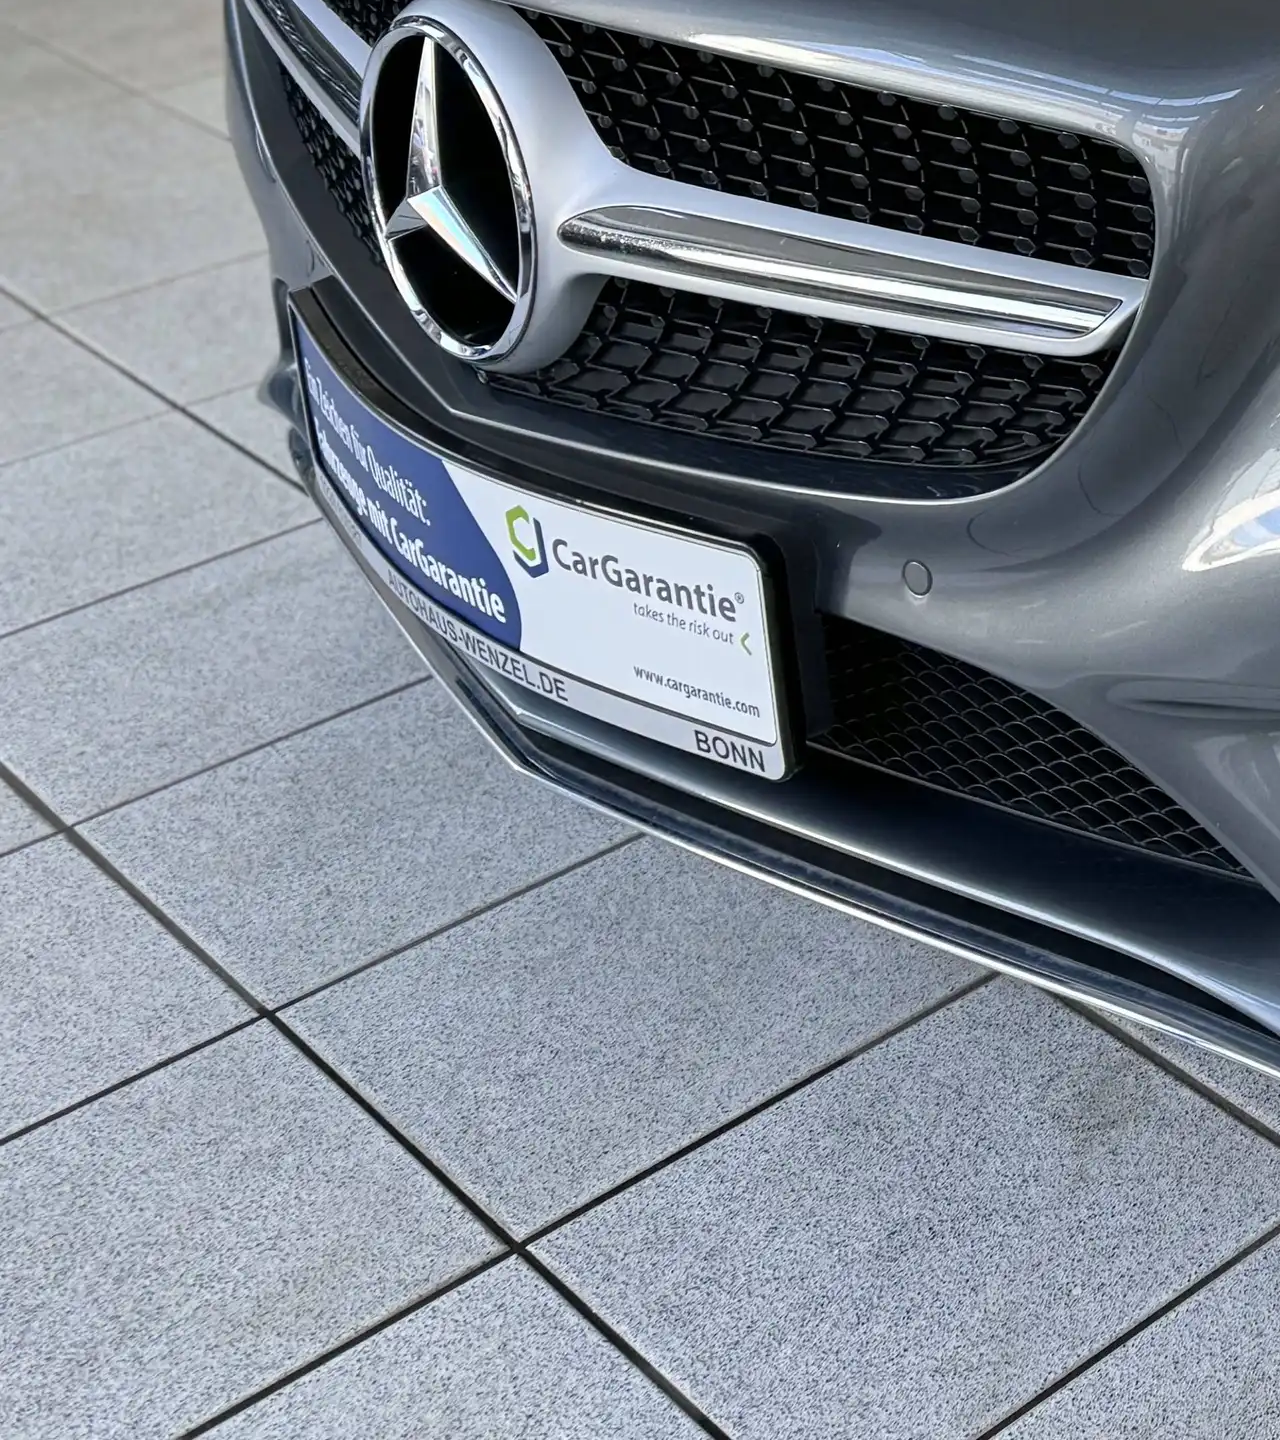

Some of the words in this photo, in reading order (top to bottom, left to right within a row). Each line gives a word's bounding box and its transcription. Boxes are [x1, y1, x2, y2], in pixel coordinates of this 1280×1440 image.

[316, 377, 354, 454] Zeichen
[366, 445, 431, 527] Qualität:
[366, 496, 393, 545] mit
[390, 517, 506, 624] CarGarantie
[388, 568, 569, 702] AUTOHAUS-WENZEL.DE
[633, 602, 664, 624] takes
[667, 612, 687, 631] the
[689, 619, 710, 638] risk
[713, 629, 734, 645] out
[633, 665, 761, 718] www.cargarantie.com
[694, 729, 766, 773] BONN
